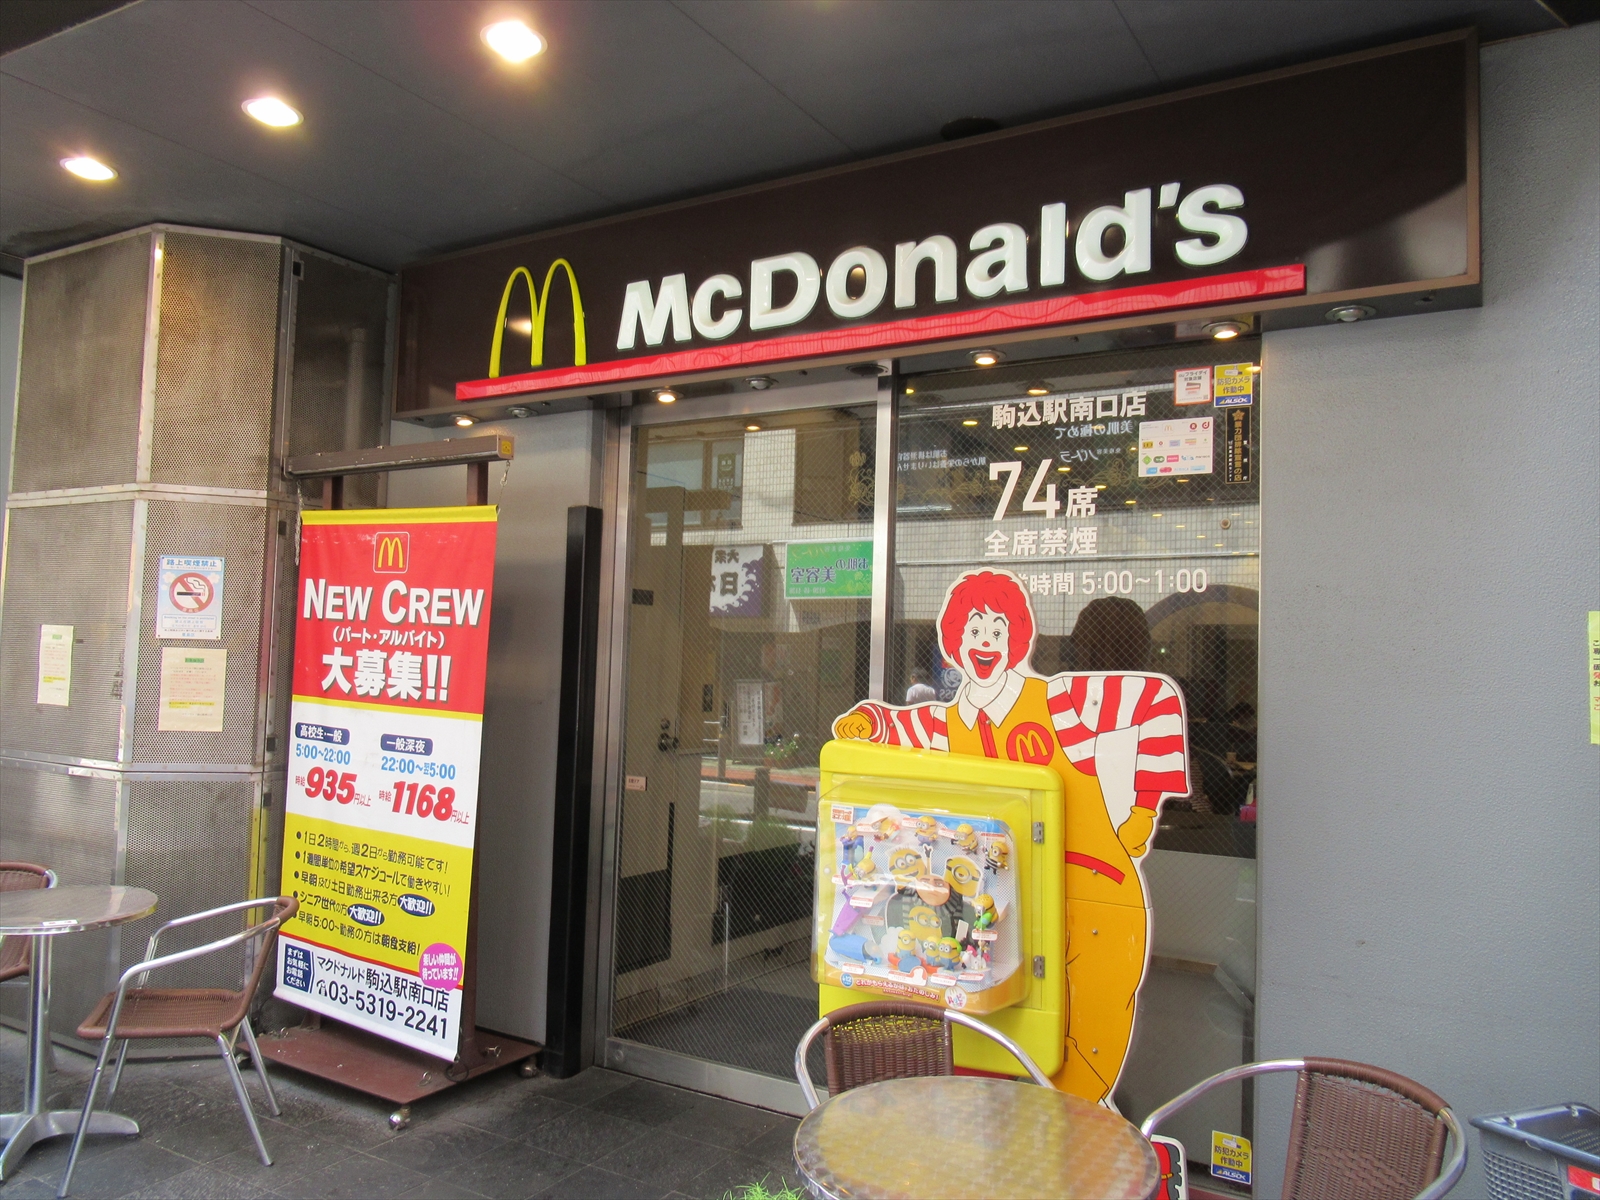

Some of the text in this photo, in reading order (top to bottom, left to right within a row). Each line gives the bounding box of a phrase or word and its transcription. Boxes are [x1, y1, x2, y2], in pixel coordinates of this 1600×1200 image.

[615, 181, 1248, 350] McDonald's
[1216, 377, 1250, 386] 防犯カメラ
[1223, 386, 1244, 394] 作動中
[991, 390, 1148, 430] 駒込駅南口店
[988, 458, 1099, 521] 74席
[984, 526, 1098, 557] 全席禁煙
[303, 578, 485, 627] NEW CREW
[321, 647, 452, 702] 大募集!!
[386, 737, 426, 754] 一般深夜
[287, 947, 304, 959] まずは
[286, 975, 306, 987] ください
[328, 981, 448, 1040] 03-5319-2241
[1214, 1145, 1249, 1160] 防犯カメラ
[1220, 1157, 1243, 1168] 作動中
[1222, 1170, 1246, 1181] ALSOK
